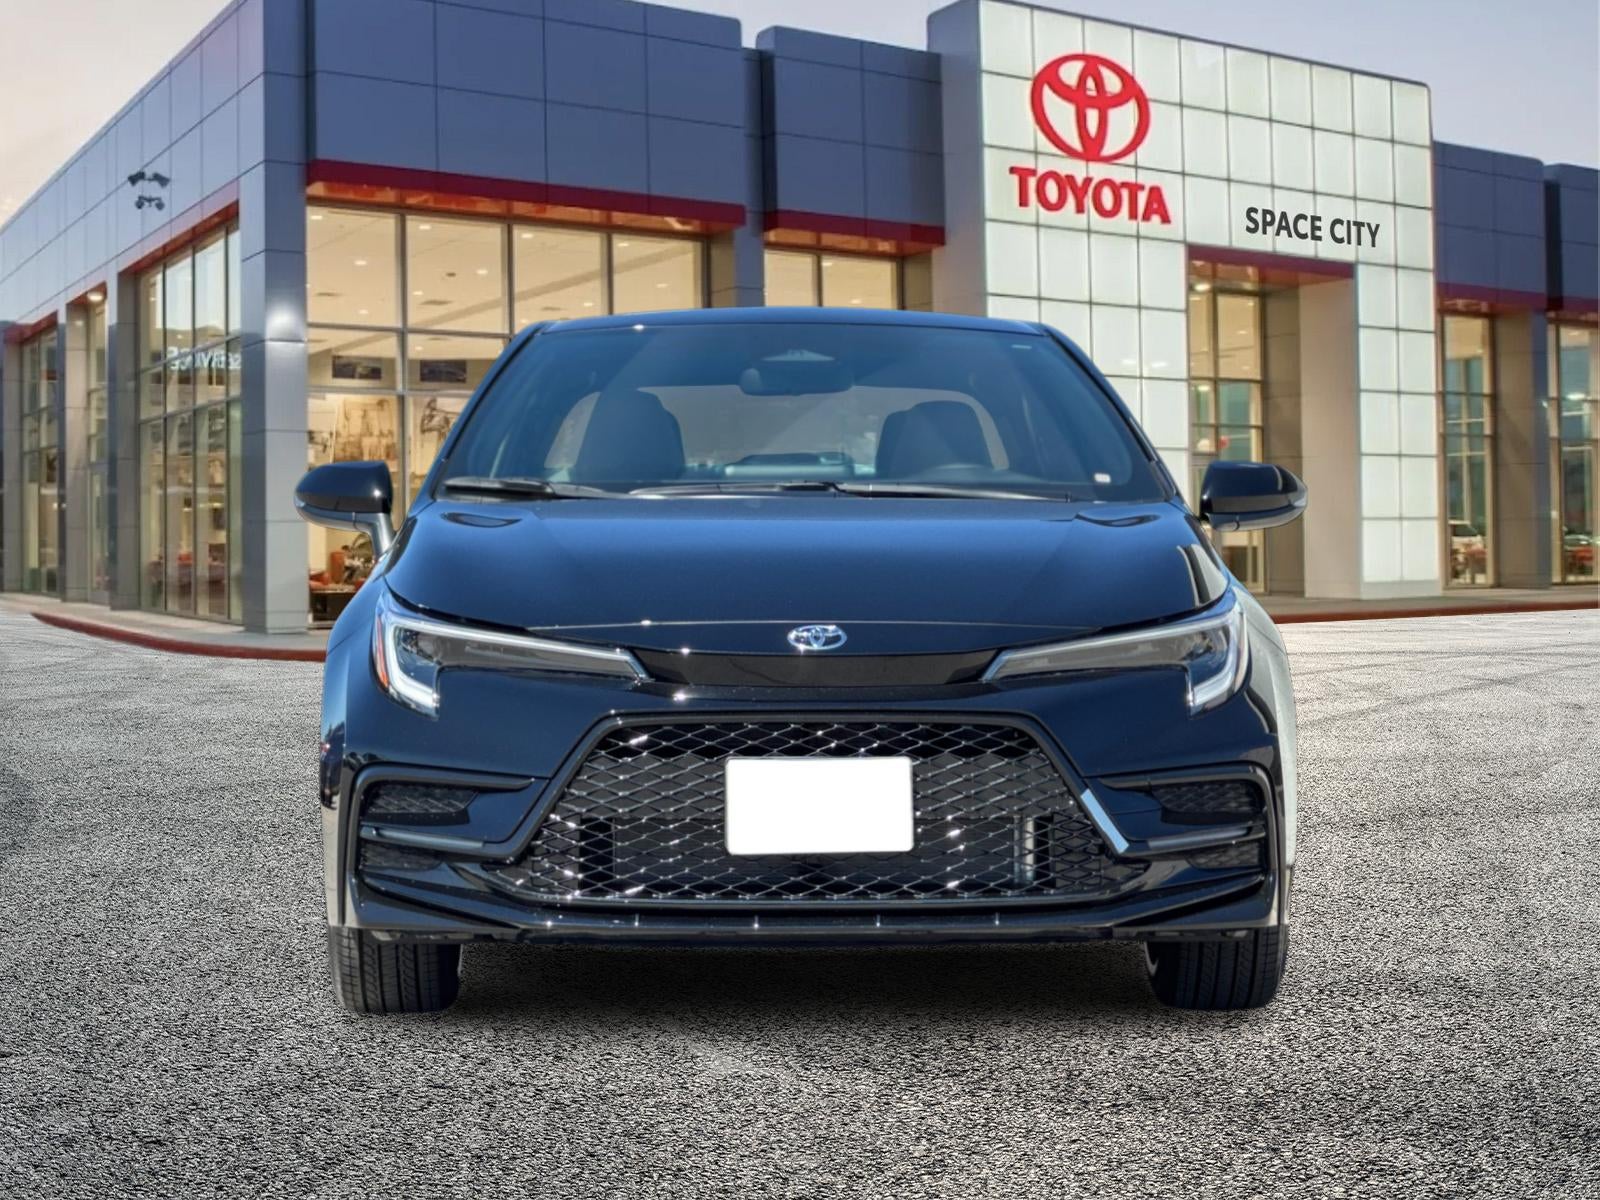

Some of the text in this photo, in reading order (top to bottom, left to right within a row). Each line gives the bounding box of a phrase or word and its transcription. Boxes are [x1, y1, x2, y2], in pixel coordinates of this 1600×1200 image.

[1009, 166, 1171, 225] TOYOTA
[1245, 206, 1381, 248] SPACE CITY
